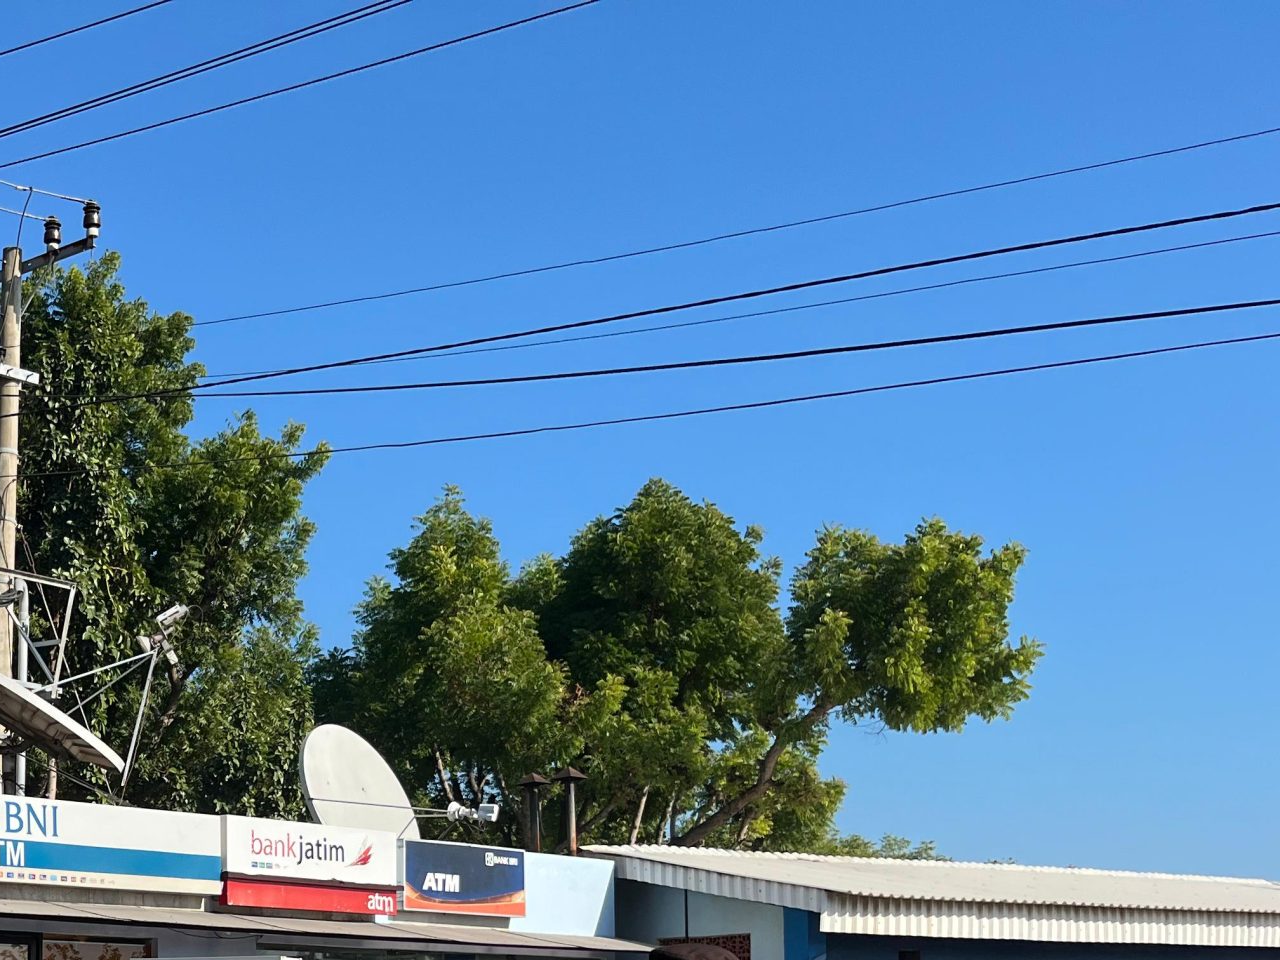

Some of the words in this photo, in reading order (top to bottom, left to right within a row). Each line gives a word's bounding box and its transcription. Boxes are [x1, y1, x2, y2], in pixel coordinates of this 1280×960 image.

[4, 801, 59, 837] BNI
[422, 872, 460, 893] ATM
[367, 892, 394, 913] atm
